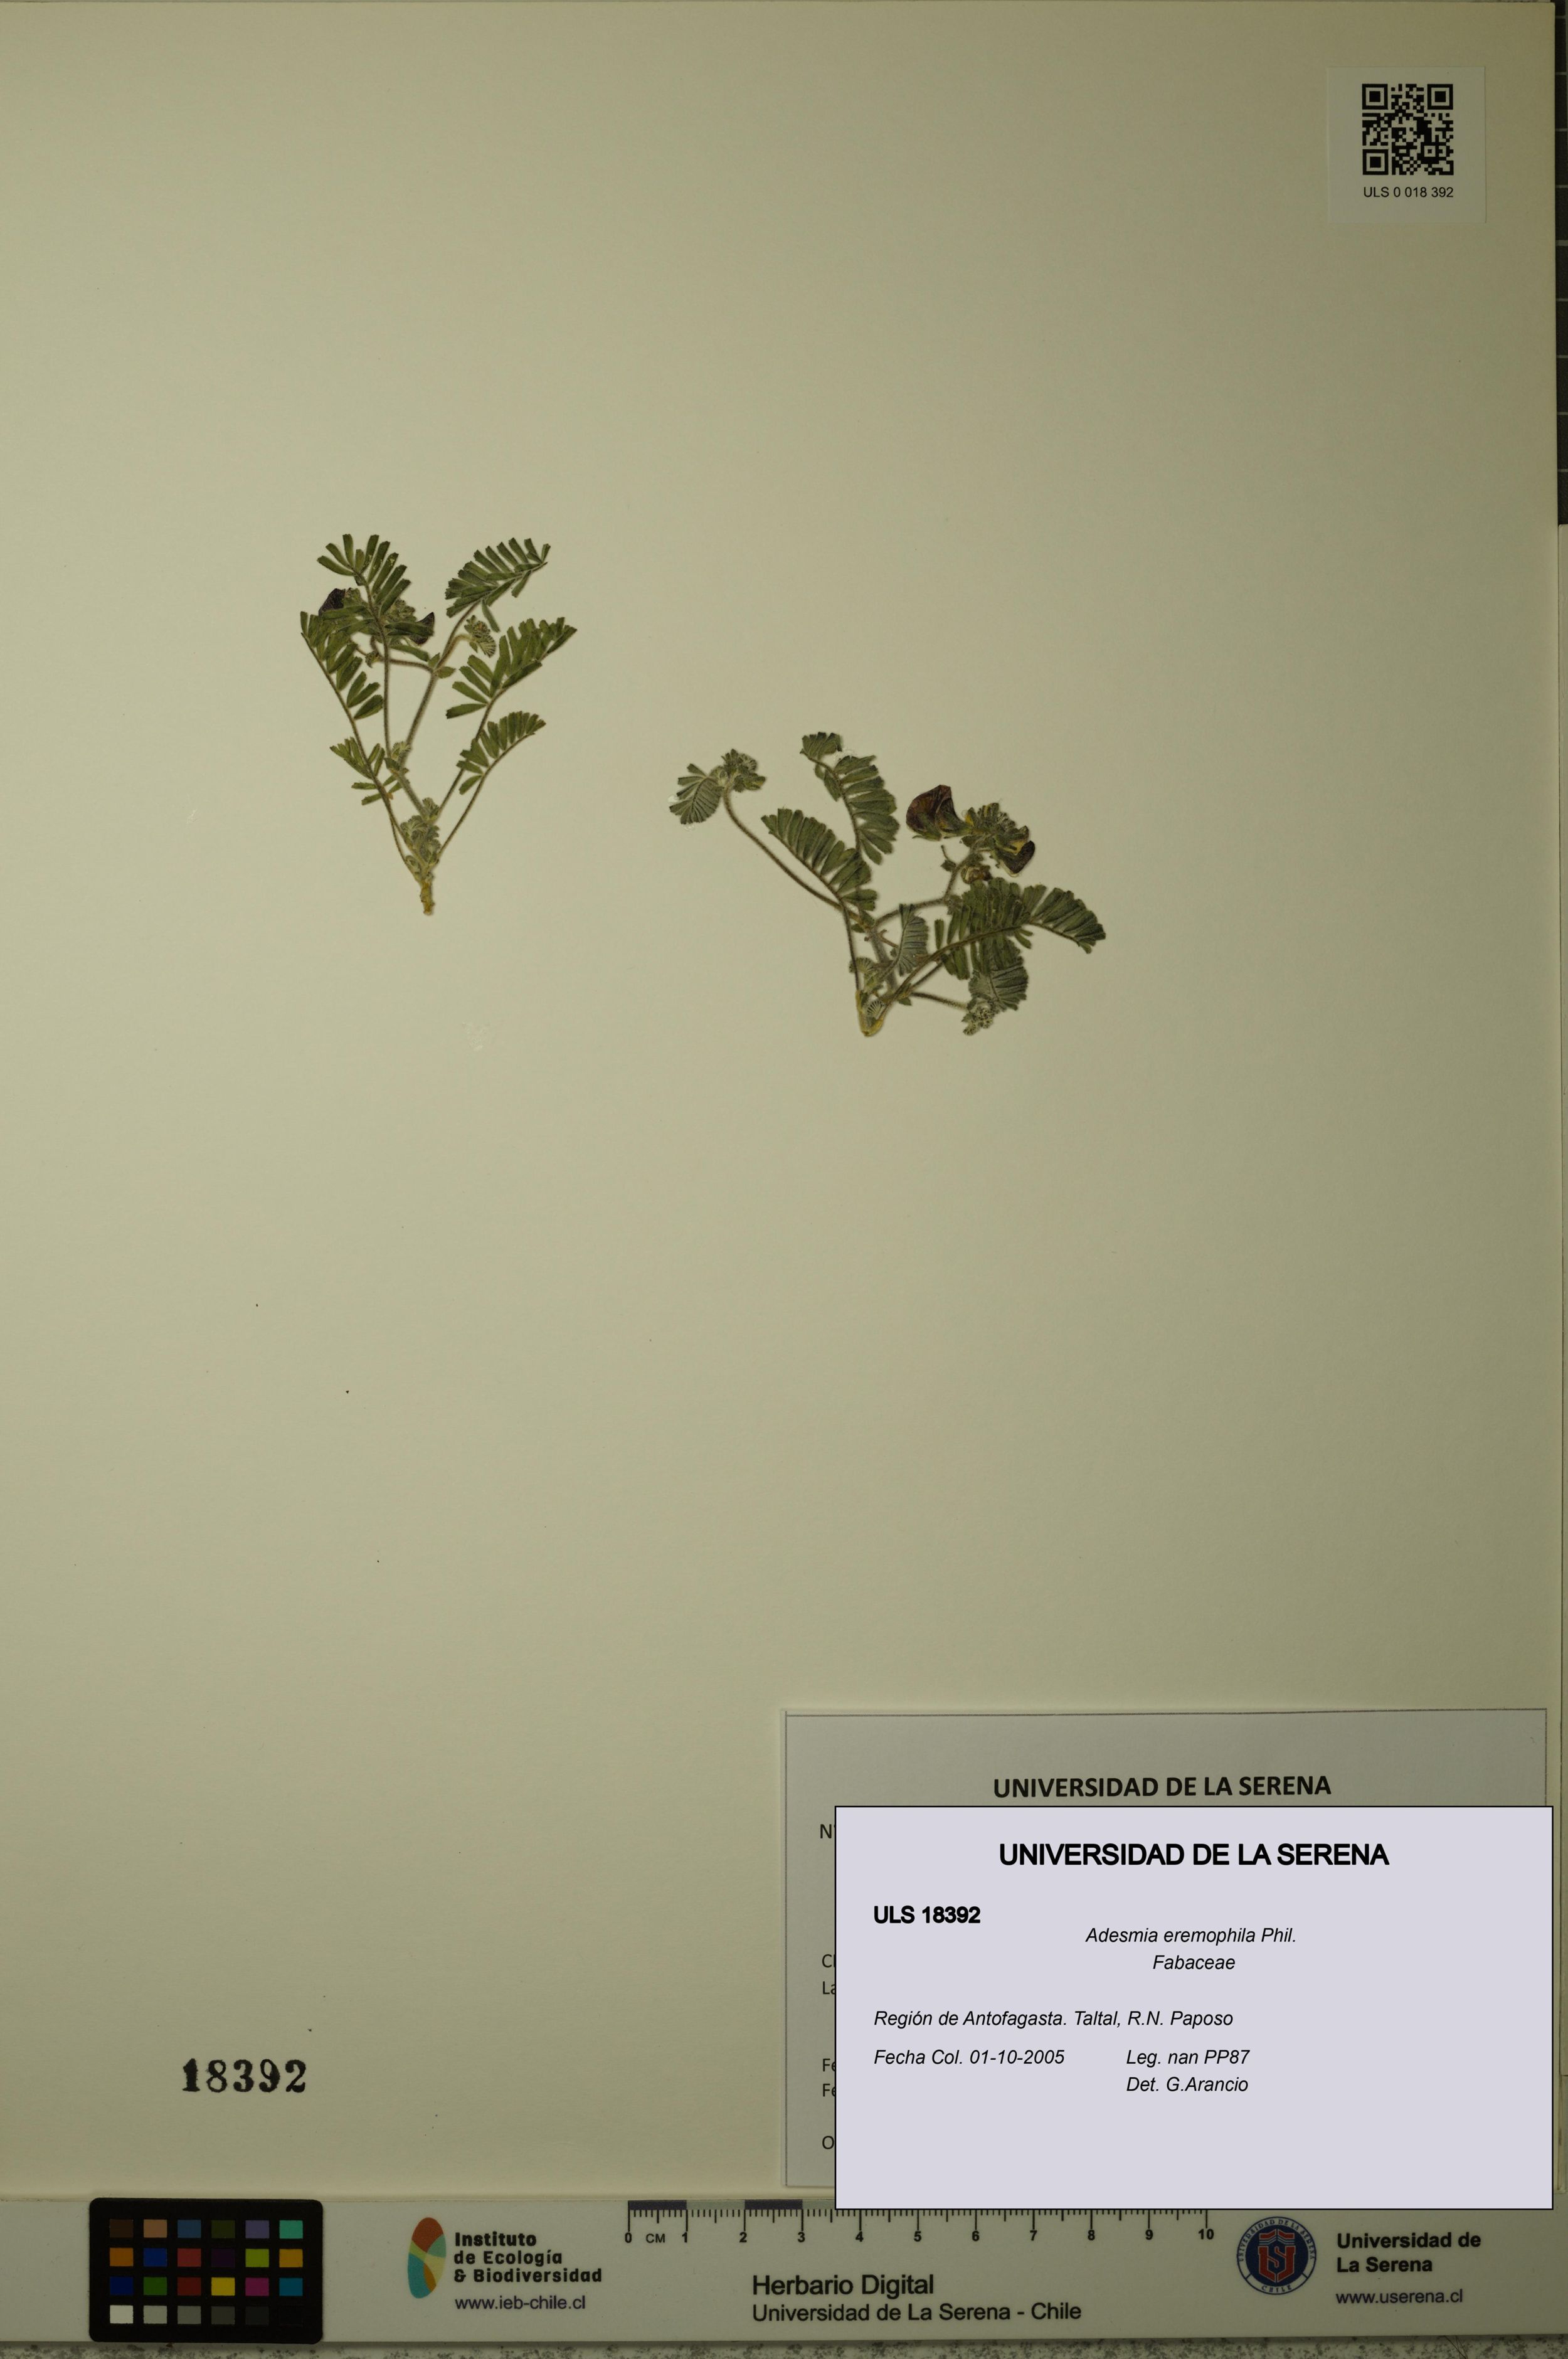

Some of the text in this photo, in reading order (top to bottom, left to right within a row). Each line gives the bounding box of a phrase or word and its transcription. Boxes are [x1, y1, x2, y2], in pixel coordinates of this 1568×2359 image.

[1364, 186, 1454, 198] ULS 0 018 392
[994, 1776, 1332, 1797] UNIVERSIDAD DE LA SERENA
[182, 2058, 307, 2093] 18392
[455, 2231, 537, 2247] Instituto
[625, 2229, 1214, 2244] 0 CM 1 2 3 4 5 6 7 8 9 10
[1337, 2232, 1481, 2249] Universidad de
[453, 2249, 562, 2267] de Ecología
[1337, 2256, 1433, 2273] La Serena
[454, 2267, 601, 2283] & Biodiversidad
[753, 2274, 934, 2300] Herbario Digital
[455, 2295, 585, 2309] www.ieb-chile.cl
[1335, 2288, 1463, 2304] www.userena.cl
[753, 2303, 869, 2322] Universidad
[876, 2303, 901, 2321] de
[908, 2303, 932, 2321] La
[939, 2303, 1010, 2321] Serena
[1031, 2302, 1082, 2320] Chile
